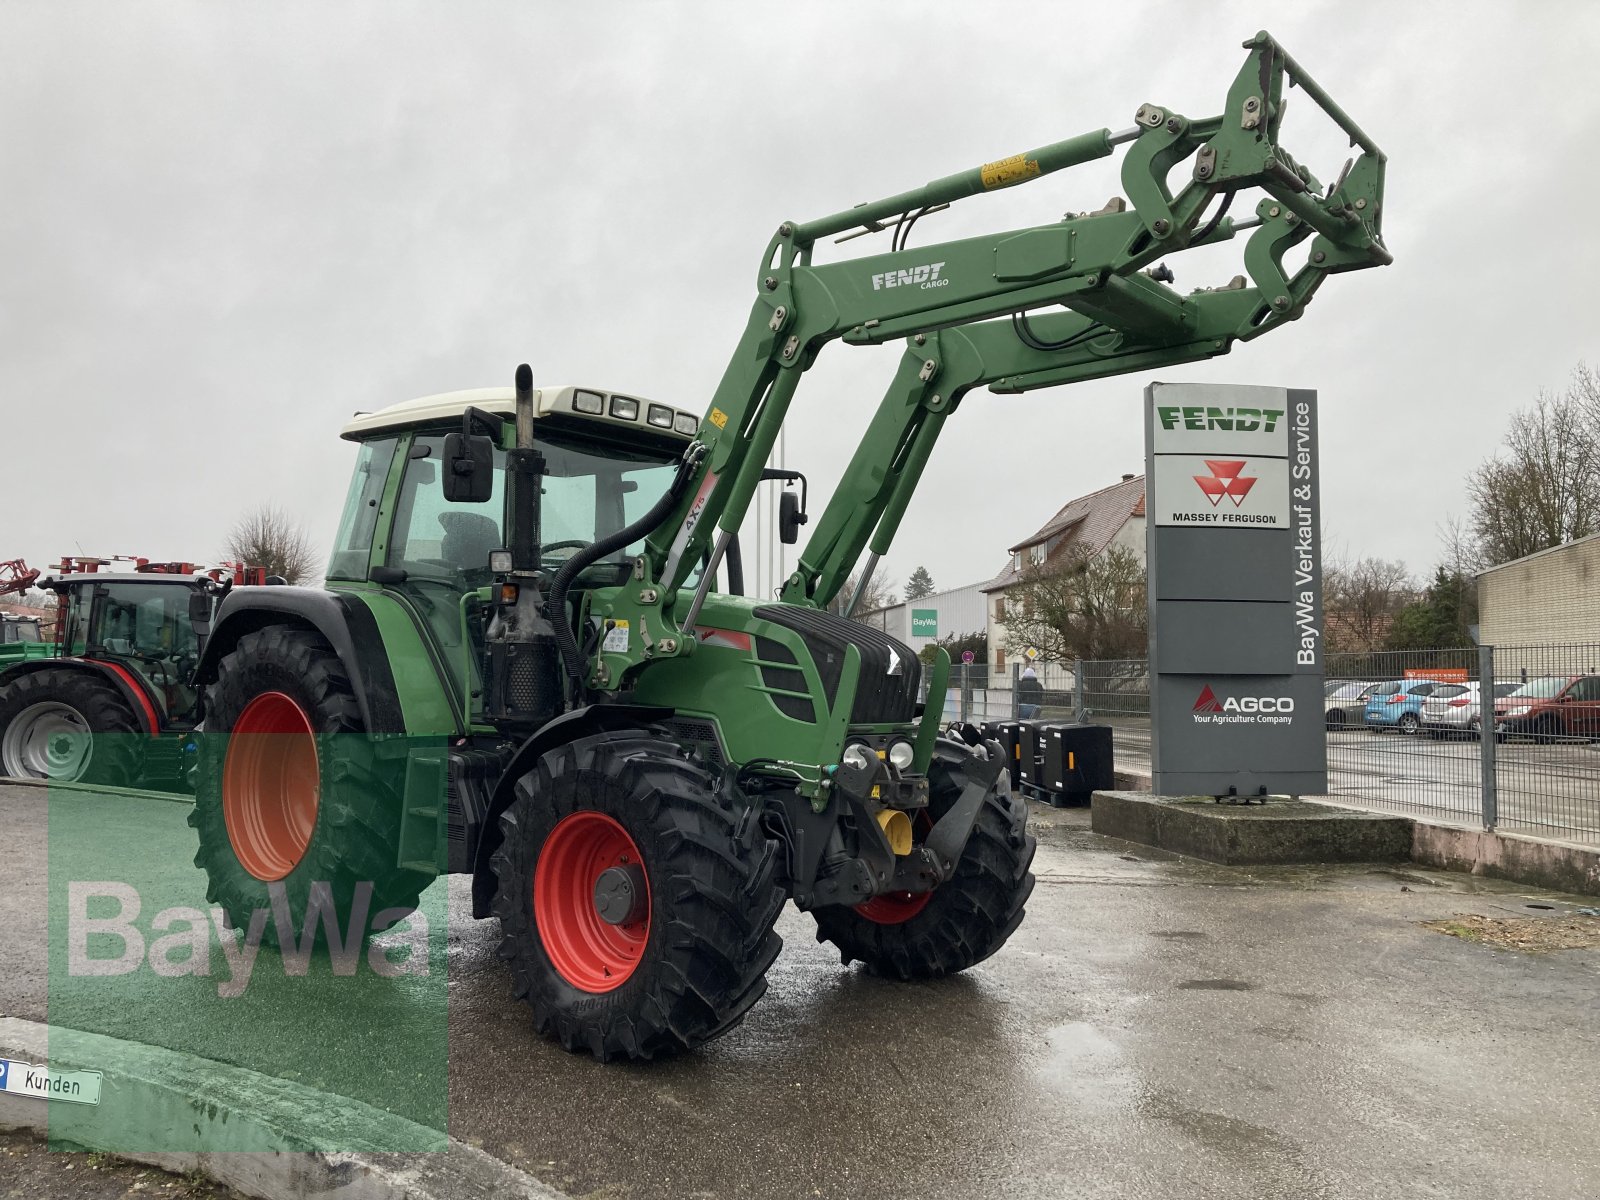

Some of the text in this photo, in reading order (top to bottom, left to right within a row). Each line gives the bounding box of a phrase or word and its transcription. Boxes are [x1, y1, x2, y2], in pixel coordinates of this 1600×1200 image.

[872, 262, 945, 290] FENDT
[920, 278, 949, 290] CARGO
[1157, 406, 1284, 432] FENDT
[686, 496, 705, 531] 4X75
[1172, 513, 1276, 524] MASSEY FERGUSON
[1292, 402, 1319, 665] BayWa Verkauf & Service
[913, 618, 937, 627] BayWa
[1223, 697, 1295, 712] AGCO
[1193, 714, 1292, 725] Your Agriculture Company
[25, 1070, 80, 1095] Kunden
